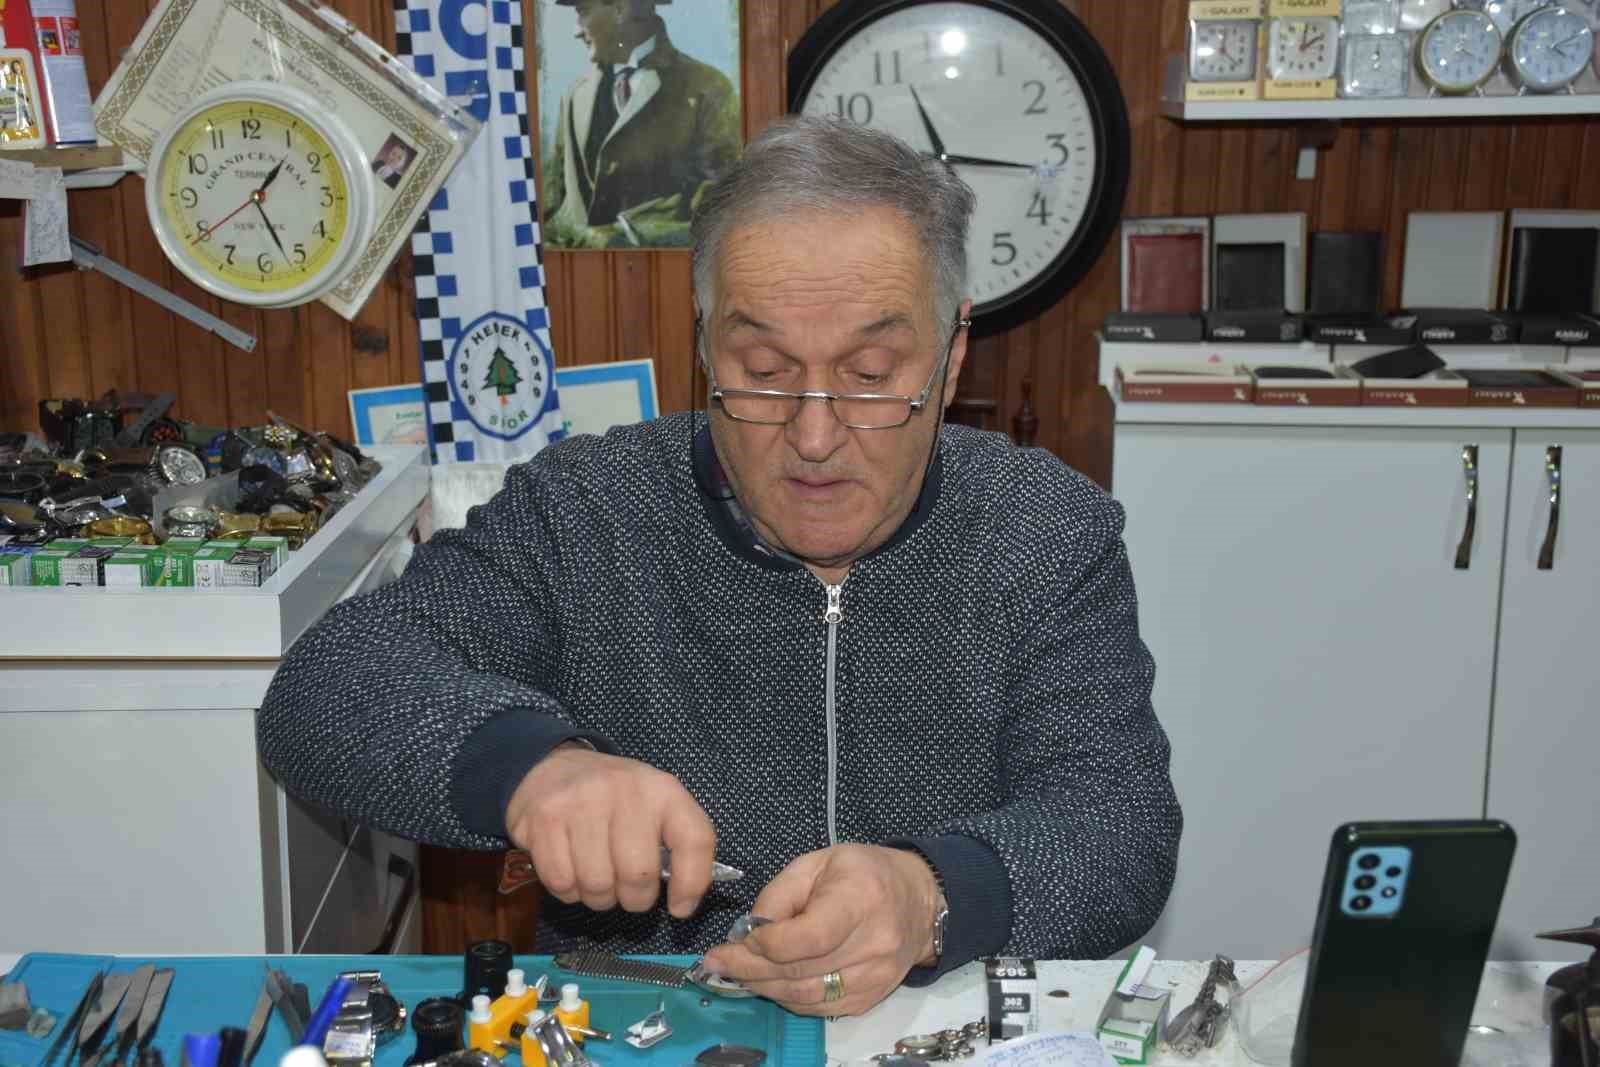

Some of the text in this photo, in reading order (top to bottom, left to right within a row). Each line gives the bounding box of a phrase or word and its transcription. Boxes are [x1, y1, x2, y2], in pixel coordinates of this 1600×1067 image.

[873, 50, 901, 86] 11
[994, 42, 1006, 77] 1
[1022, 80, 1048, 116] 2
[836, 92, 873, 128] 10
[211, 129, 225, 150] 11
[241, 118, 261, 140] 12
[285, 129, 292, 149] 1
[1045, 133, 1070, 168] 3
[188, 153, 208, 175] 10
[205, 152, 307, 190] GRAND CENRAL
[307, 151, 321, 174] 2
[180, 187, 198, 209] 9
[320, 186, 334, 208] 3
[1026, 192, 1053, 226] 4
[196, 219, 212, 243] 8
[311, 219, 328, 239] 4
[223, 245, 237, 266] 7
[292, 243, 307, 265] 5
[990, 232, 1018, 266] 5
[257, 252, 273, 274] 6
